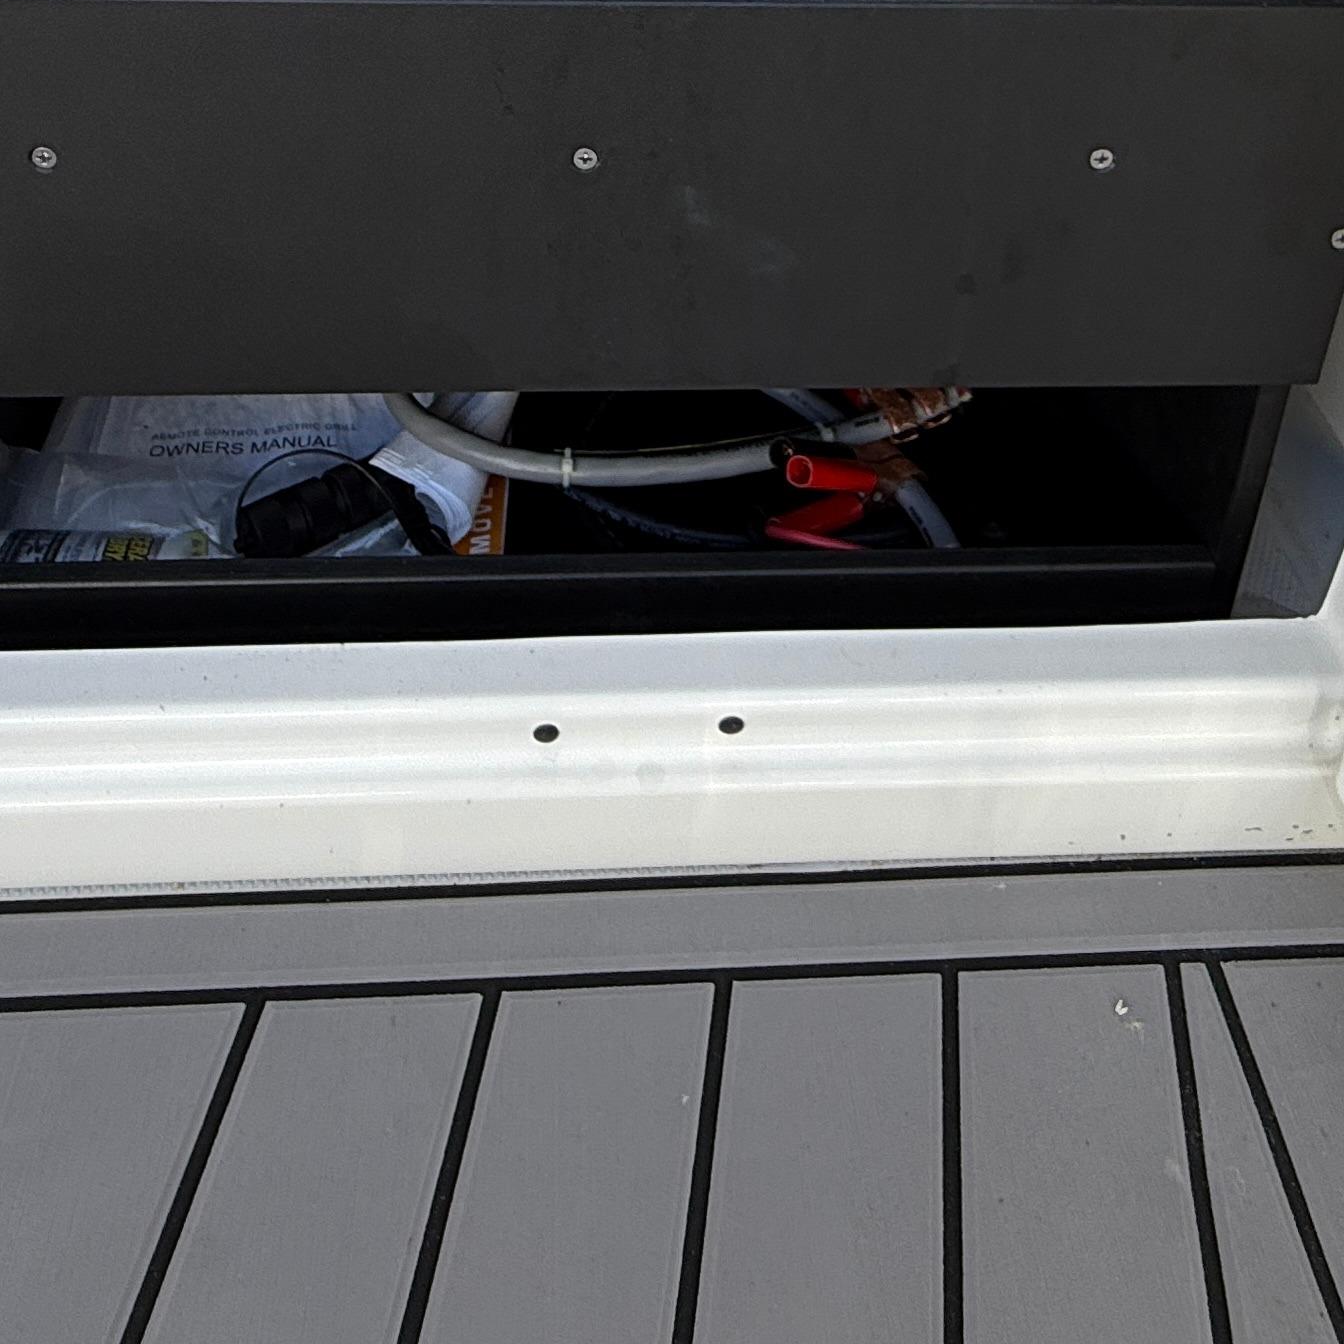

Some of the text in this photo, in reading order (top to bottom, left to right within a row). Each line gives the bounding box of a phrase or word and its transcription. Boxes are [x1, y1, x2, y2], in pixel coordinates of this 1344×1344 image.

[151, 429, 200, 441] REMOTE
[204, 427, 260, 437] CONTROL
[263, 422, 322, 435] ELECTRIC
[149, 435, 337, 457] OWNERS MANUAL
